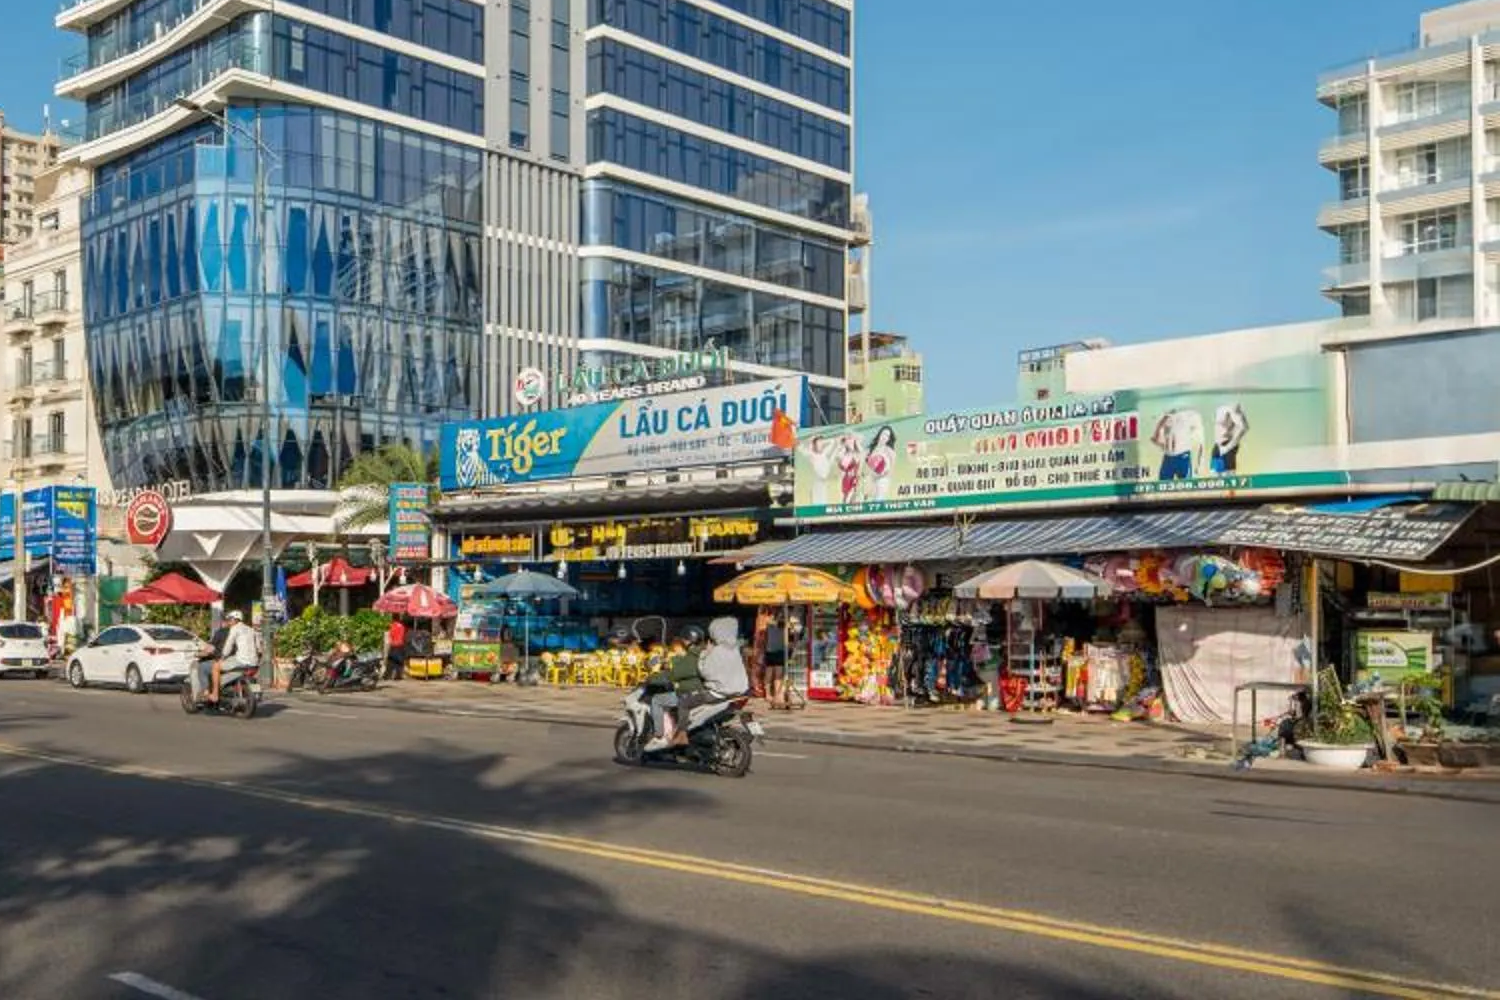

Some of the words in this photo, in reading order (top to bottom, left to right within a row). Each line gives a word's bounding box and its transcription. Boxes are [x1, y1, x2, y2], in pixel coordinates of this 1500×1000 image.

[594, 385, 644, 402] YEARS
[646, 375, 706, 395] BRAND
[619, 400, 668, 440] LẨU
[676, 399, 711, 433] CÁ
[720, 385, 788, 428] ĐUỐI
[486, 419, 568, 474] Tiger
